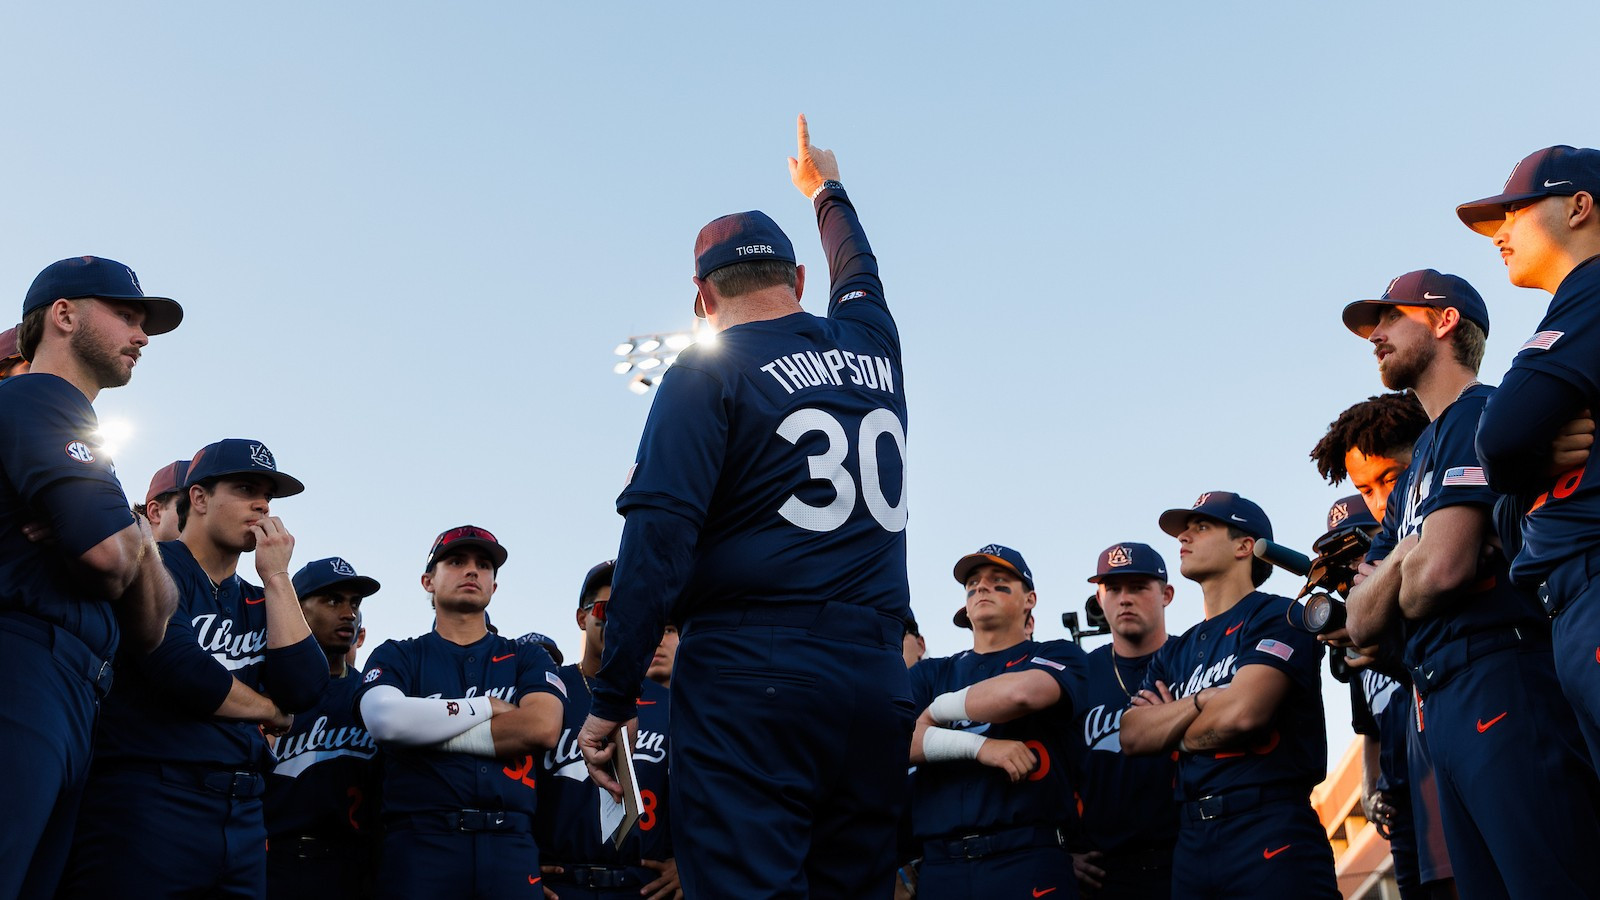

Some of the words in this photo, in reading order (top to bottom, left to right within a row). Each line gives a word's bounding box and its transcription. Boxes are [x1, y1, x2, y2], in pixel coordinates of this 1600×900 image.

[759, 348, 895, 395] THOMPSON
[67, 441, 94, 462] SEC
[775, 407, 909, 533] 30
